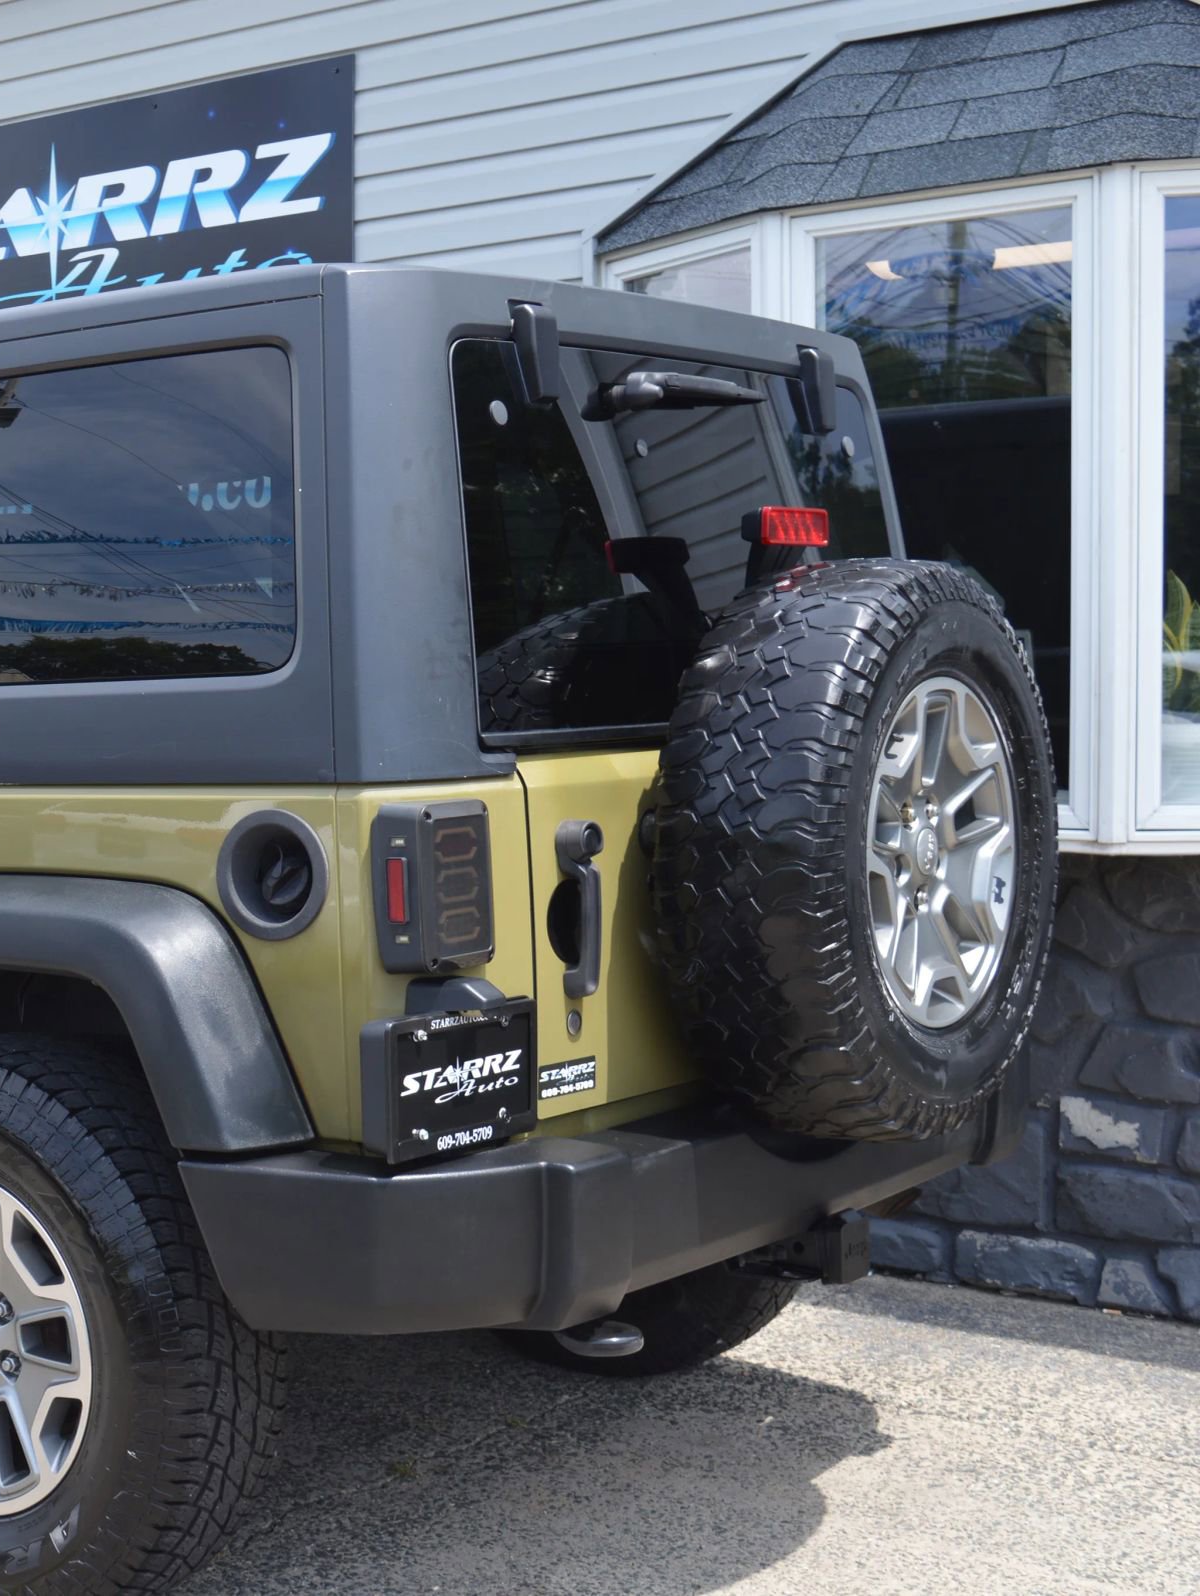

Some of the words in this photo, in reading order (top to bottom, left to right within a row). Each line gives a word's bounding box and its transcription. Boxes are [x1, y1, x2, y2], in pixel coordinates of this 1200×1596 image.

[400, 1049, 522, 1097] STARRZ
[539, 1061, 596, 1083] STARRZ
[434, 1076, 519, 1104] Auto
[436, 1125, 493, 1151] 609-704-5709
